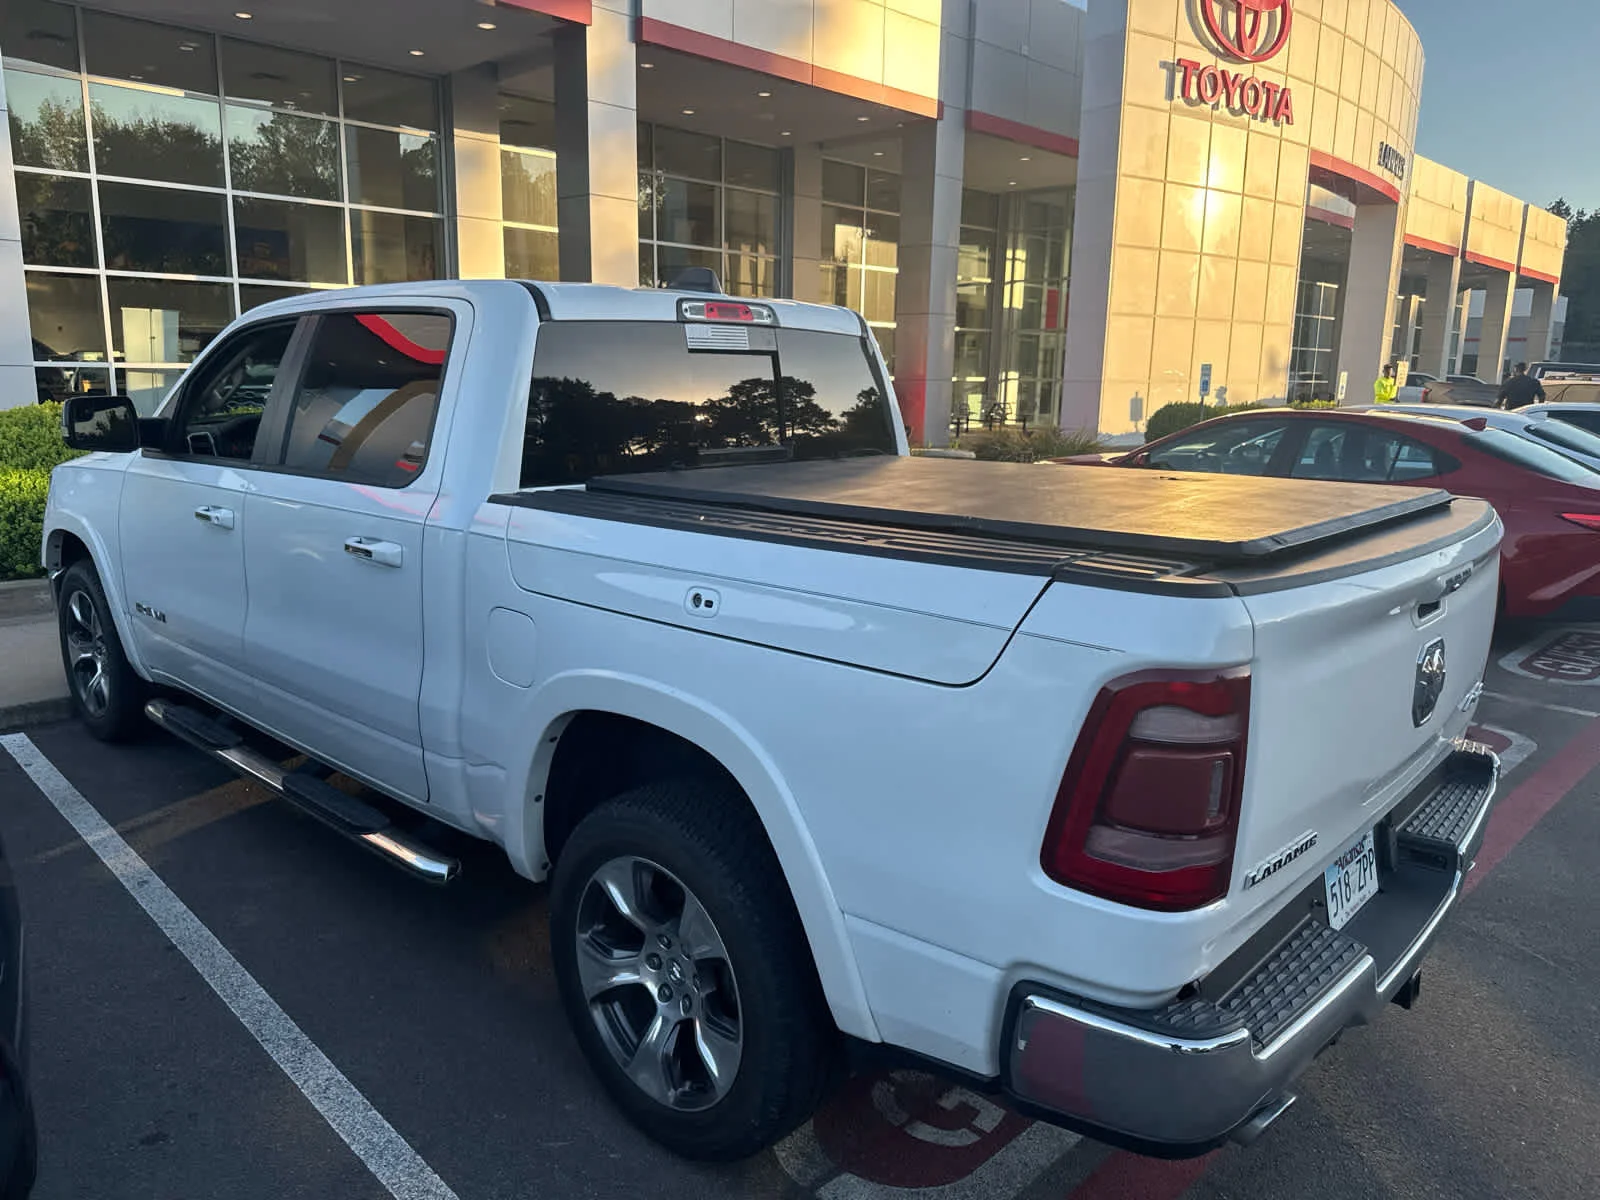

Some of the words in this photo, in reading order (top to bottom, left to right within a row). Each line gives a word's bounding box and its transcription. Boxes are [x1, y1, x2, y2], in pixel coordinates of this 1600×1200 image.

[1176, 57, 1294, 125] TOYOTA
[1245, 831, 1318, 889] LARAMIE
[1330, 870, 1352, 918] 518
[1356, 847, 1375, 893] ZPP
